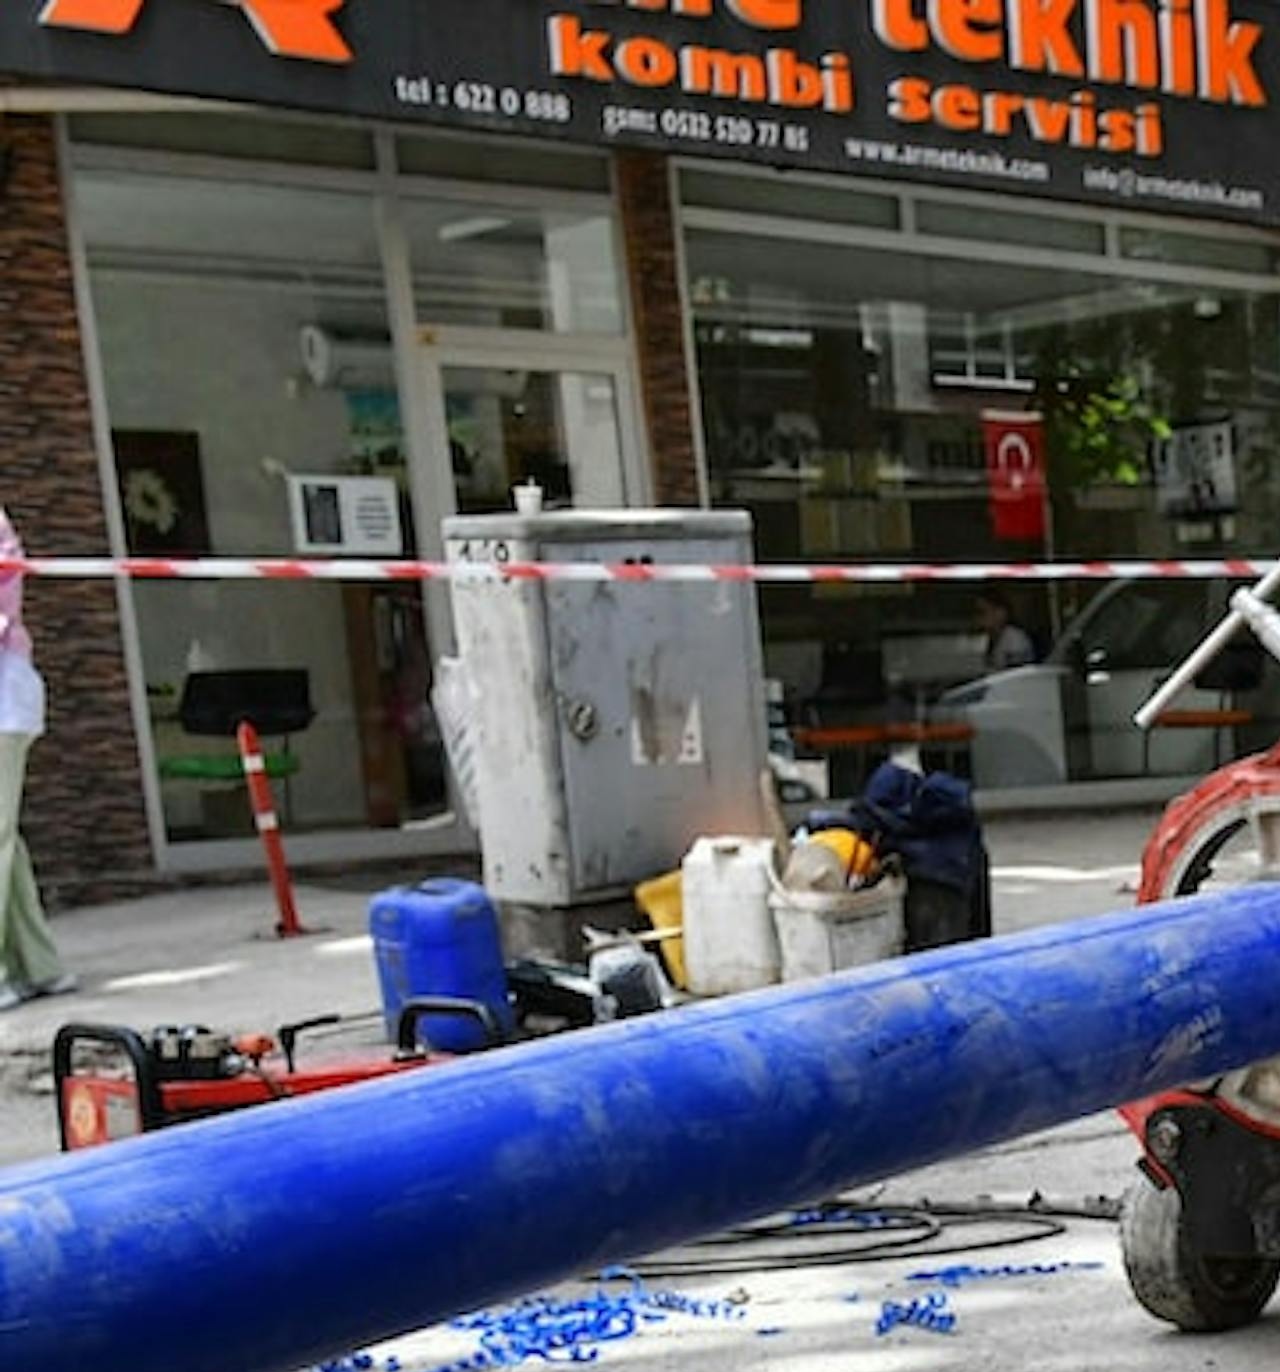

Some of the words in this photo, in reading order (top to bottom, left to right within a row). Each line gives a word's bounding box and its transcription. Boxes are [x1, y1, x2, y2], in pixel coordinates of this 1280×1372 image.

[395, 76, 431, 104] tel
[549, 14, 852, 112] kombi
[886, 75, 1162, 156] servisi
